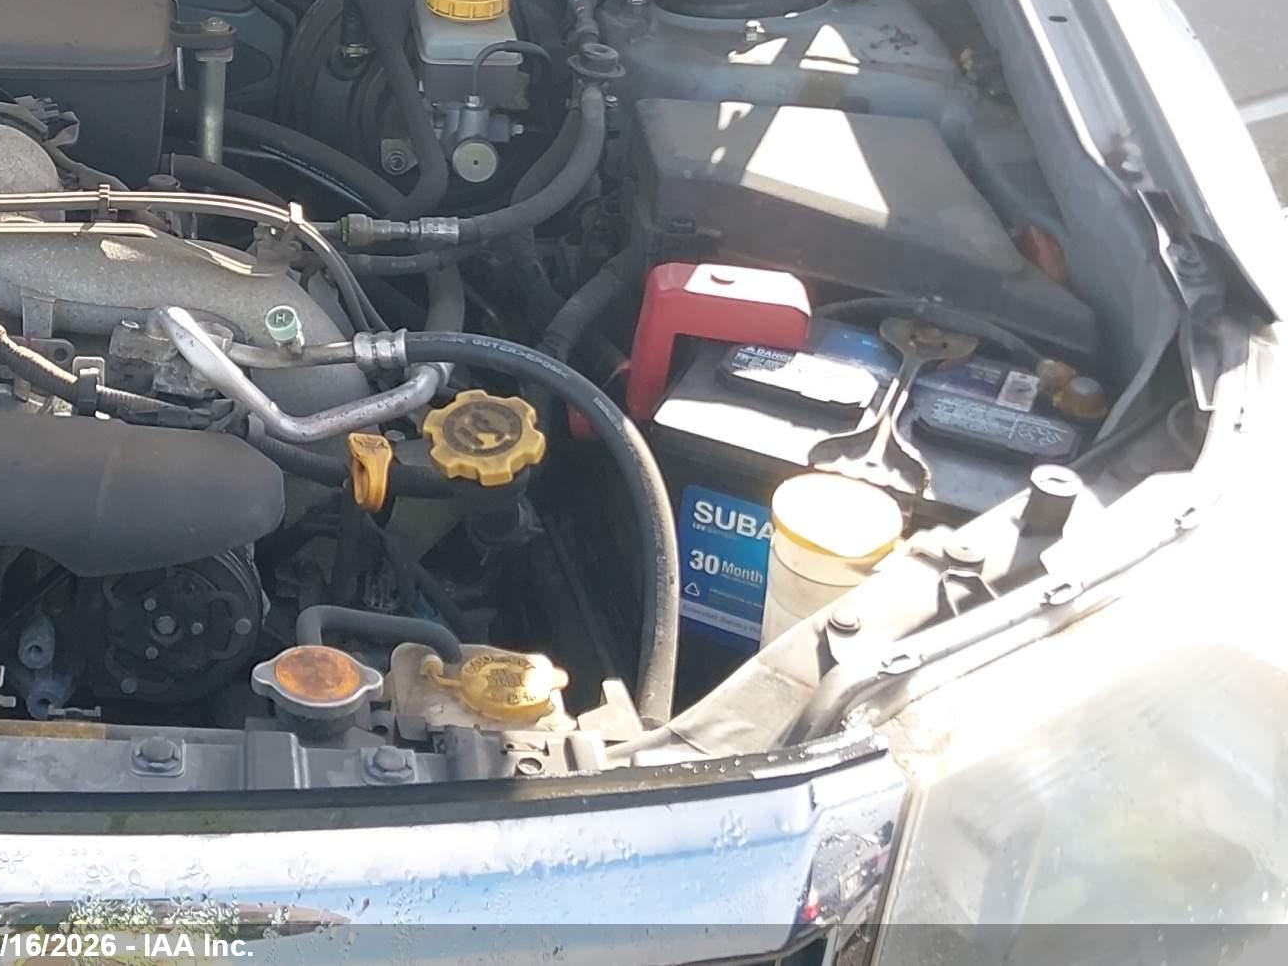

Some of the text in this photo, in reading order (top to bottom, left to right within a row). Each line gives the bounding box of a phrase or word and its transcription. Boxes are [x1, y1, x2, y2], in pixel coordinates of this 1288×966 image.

[693, 500, 775, 541] SUBA
[689, 549, 720, 576] 30
[722, 559, 764, 584] Month
